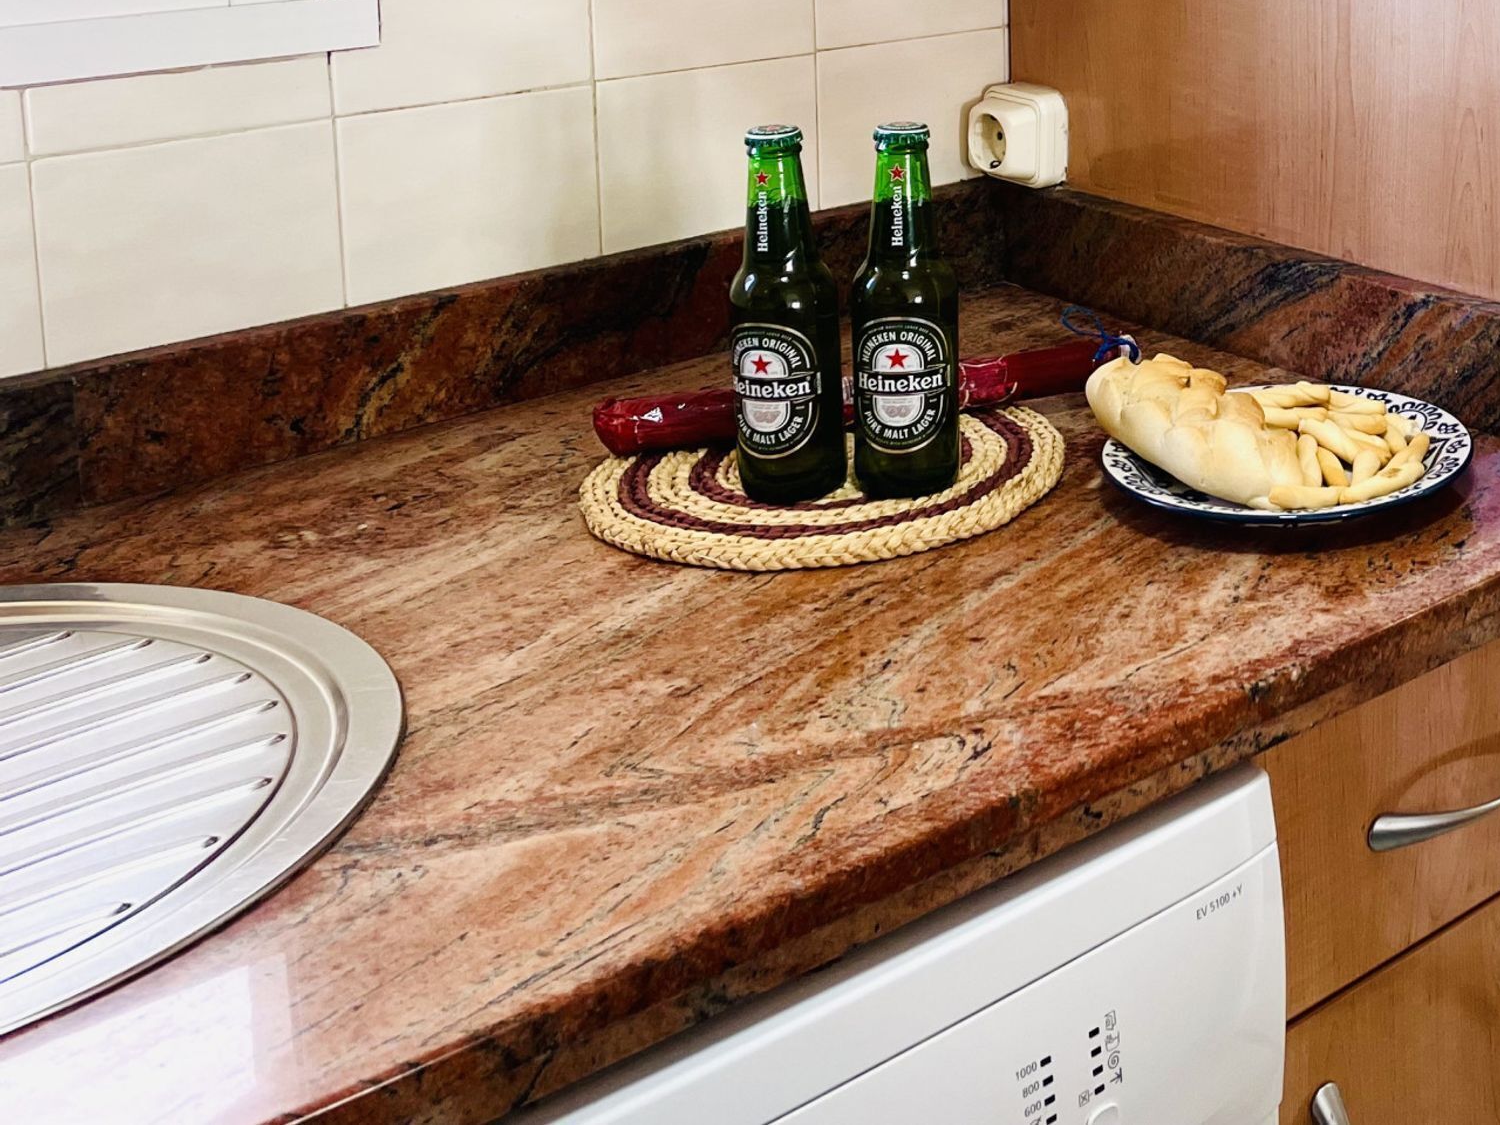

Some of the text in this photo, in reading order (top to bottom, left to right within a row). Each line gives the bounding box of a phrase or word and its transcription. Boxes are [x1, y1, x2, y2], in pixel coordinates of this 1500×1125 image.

[757, 191, 769, 252] Heineken
[891, 185, 904, 247] Heineken
[762, 337, 802, 369] ORIGINAL
[861, 331, 937, 363] HEINEKEN ORIGINAL
[858, 371, 943, 393] Heineken
[753, 434, 776, 445] MALT
[779, 415, 804, 442] LAGER
[864, 410, 882, 434] PURE
[883, 428, 909, 440] MALT
[912, 408, 936, 435] LAGER
[1196, 905, 1208, 920] EV
[1209, 892, 1231, 913] 5100
[1015, 1061, 1038, 1081] 1000
[1022, 1080, 1040, 1099] 800
[1024, 1100, 1042, 1118] 600
